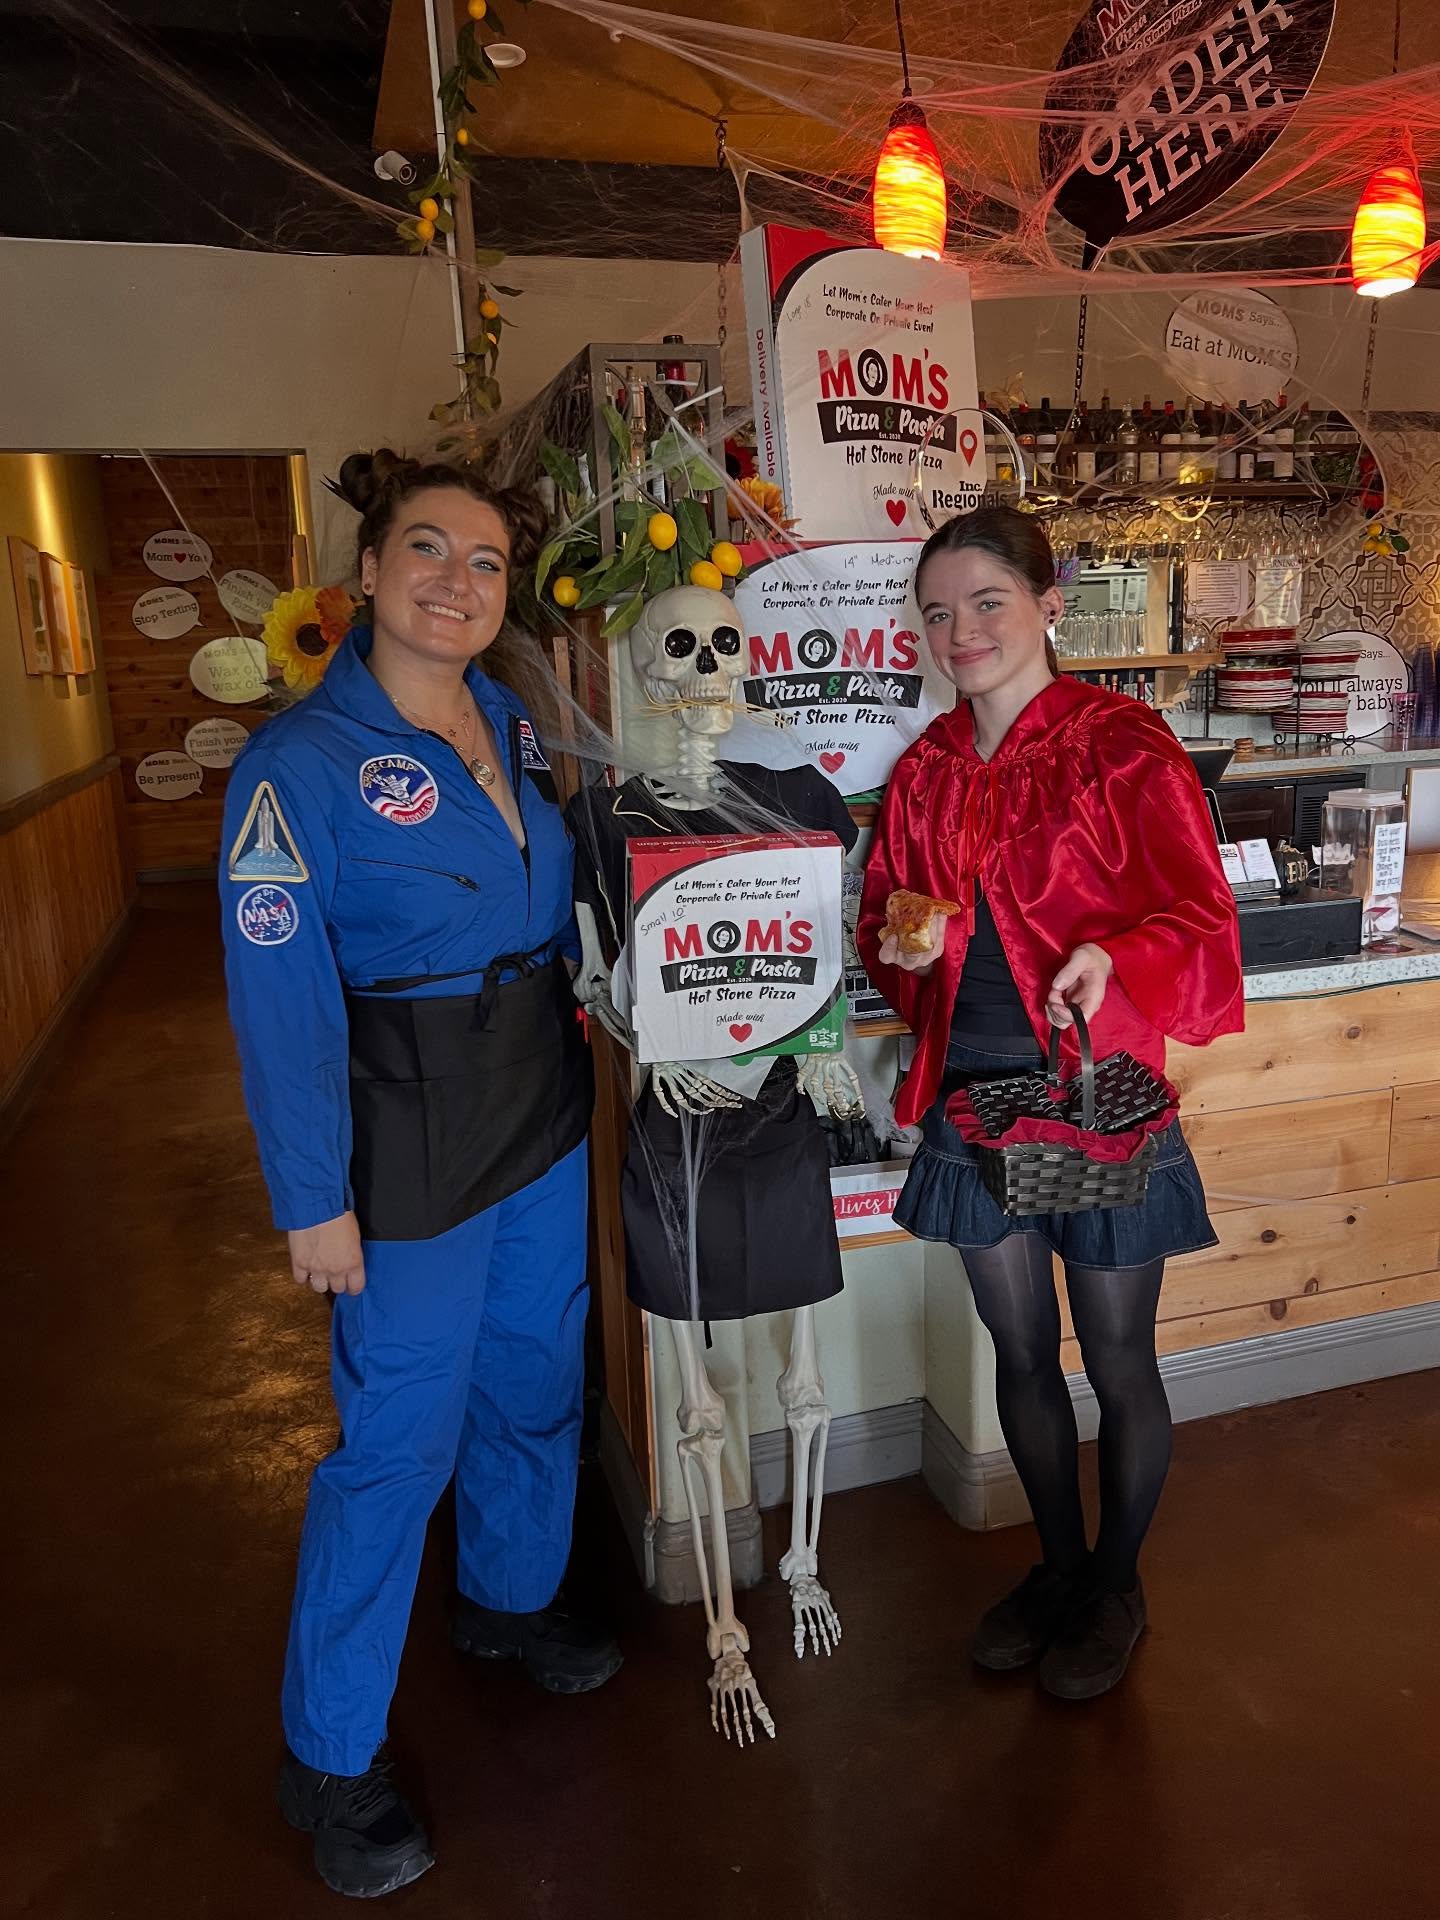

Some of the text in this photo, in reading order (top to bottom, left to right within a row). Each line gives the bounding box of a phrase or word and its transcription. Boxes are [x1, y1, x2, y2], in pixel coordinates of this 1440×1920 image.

[1081, 0, 1294, 175] ORDER
[1114, 54, 1285, 220] HERE
[823, 284, 836, 297] Let
[839, 286, 867, 304] Mom's
[870, 293, 892, 308] Cater
[825, 304, 867, 323] Corporate
[913, 319, 934, 333] Event
[1170, 329, 1293, 369] Eat at MOM'S
[817, 347, 949, 410] MOM'S
[756, 328, 775, 477] Delivery Available
[836, 405, 945, 441] Pizza & Pasta
[846, 444, 943, 470] Hot Stone Pzza
[873, 482, 897, 501] Made
[959, 481, 983, 492] Inc.
[146, 552, 173, 562] Mom
[871, 553, 914, 566] Medium
[762, 578, 909, 593] Let Mom's Cater Your Next
[763, 593, 907, 610] Corporate Or Private Event
[134, 602, 198, 626] Stop Texting
[749, 618, 921, 677] MOM'S
[764, 675, 905, 704] Pizza & Pasta
[1346, 678, 1403, 694] always
[1356, 694, 1395, 712] baby
[805, 709, 848, 725] Stone
[854, 709, 896, 725] Pizza
[189, 738, 221, 748] Finish
[192, 746, 220, 758] home
[805, 739, 861, 755] Made with
[138, 771, 200, 785] Be present
[674, 876, 801, 891] Let Mom's Cater Your Next
[676, 889, 801, 905] Corporate Or Private Event
[244, 907, 291, 926] NASA
[640, 912, 667, 937] Small
[663, 911, 814, 962] MOM'S
[679, 958, 802, 985] Pizza & Pasta
[688, 986, 796, 1005] Hot Stone Pizza
[716, 1012, 765, 1026] Made with
[809, 1032, 839, 1043] BEST
[839, 1198, 885, 1215] Lives
